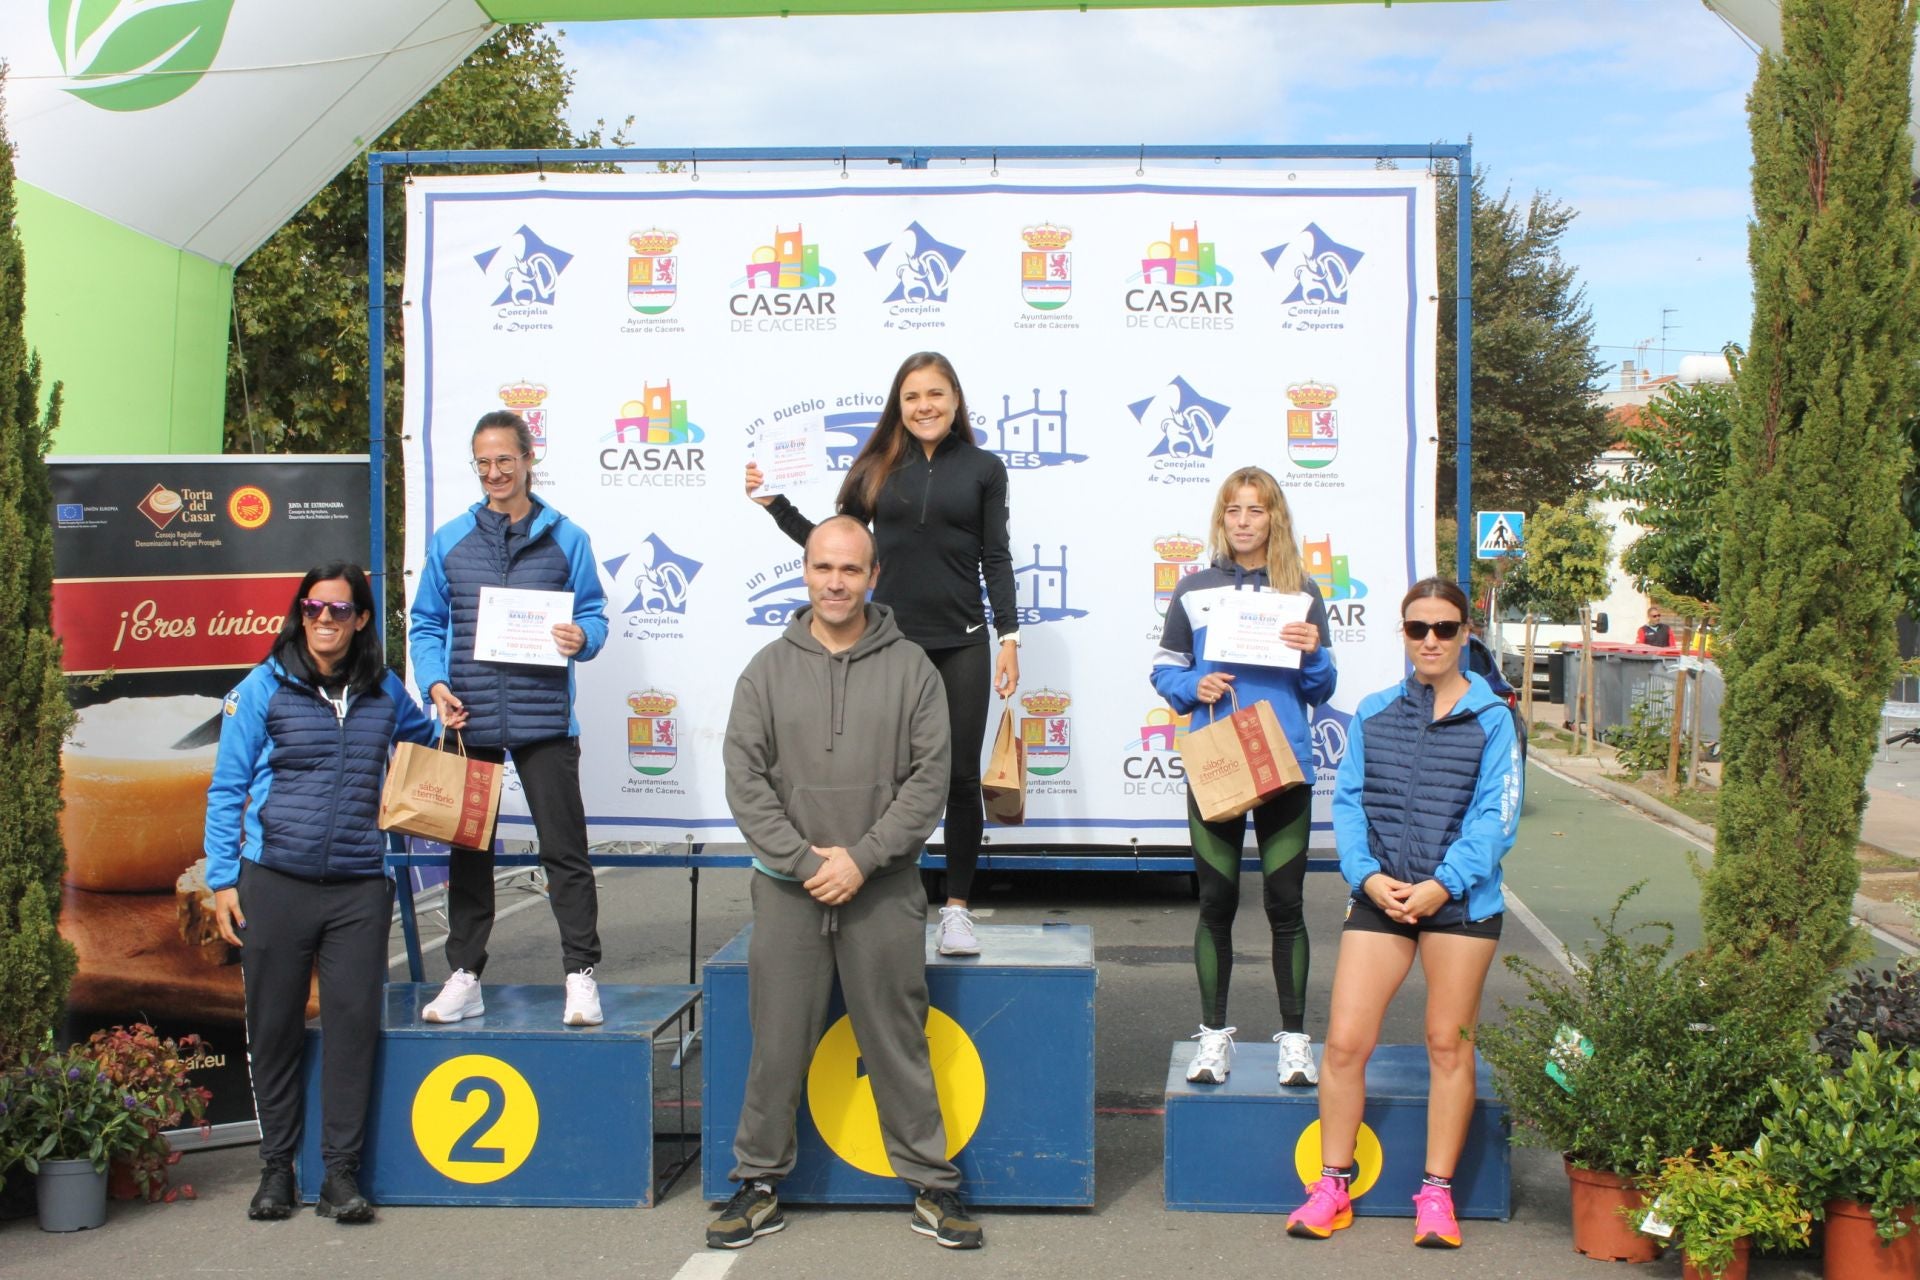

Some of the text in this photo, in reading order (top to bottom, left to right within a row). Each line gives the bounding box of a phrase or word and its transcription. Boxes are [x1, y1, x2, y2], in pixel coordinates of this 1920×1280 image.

[729, 292, 836, 316] CASAR
[1125, 289, 1233, 314] CASAR
[1020, 313, 1073, 321] Ayuntamiento
[1126, 315, 1149, 328] DE
[492, 321, 553, 332] de Deportes
[730, 319, 753, 333] DE
[883, 319, 946, 330] de Deportes
[1013, 321, 1036, 329] Casar
[1037, 321, 1047, 329] de
[1281, 320, 1344, 332] de Deportes
[745, 392, 884, 436] un pueblo activo
[599, 448, 705, 471] CASAR
[601, 473, 623, 487] DE
[1148, 473, 1211, 484] de Deportes
[1286, 472, 1339, 480] Ayuntamiento
[181, 488, 213, 500] Torta
[189, 500, 207, 511] del
[182, 511, 216, 522] Casar
[155, 531, 202, 540] Consejo Regulador
[136, 540, 171, 548] Denominación
[180, 539, 198, 548] Origen
[198, 539, 222, 548] Protegida
[745, 557, 804, 590] un pue
[113, 600, 285, 651] ¡Eres única
[623, 630, 684, 640] de Deportes
[1123, 757, 1186, 779] CAS
[628, 778, 679, 786] Ayuntamiento
[621, 786, 643, 794] Casar
[1124, 782, 1147, 795] DE
[448, 1076, 506, 1164] 2
